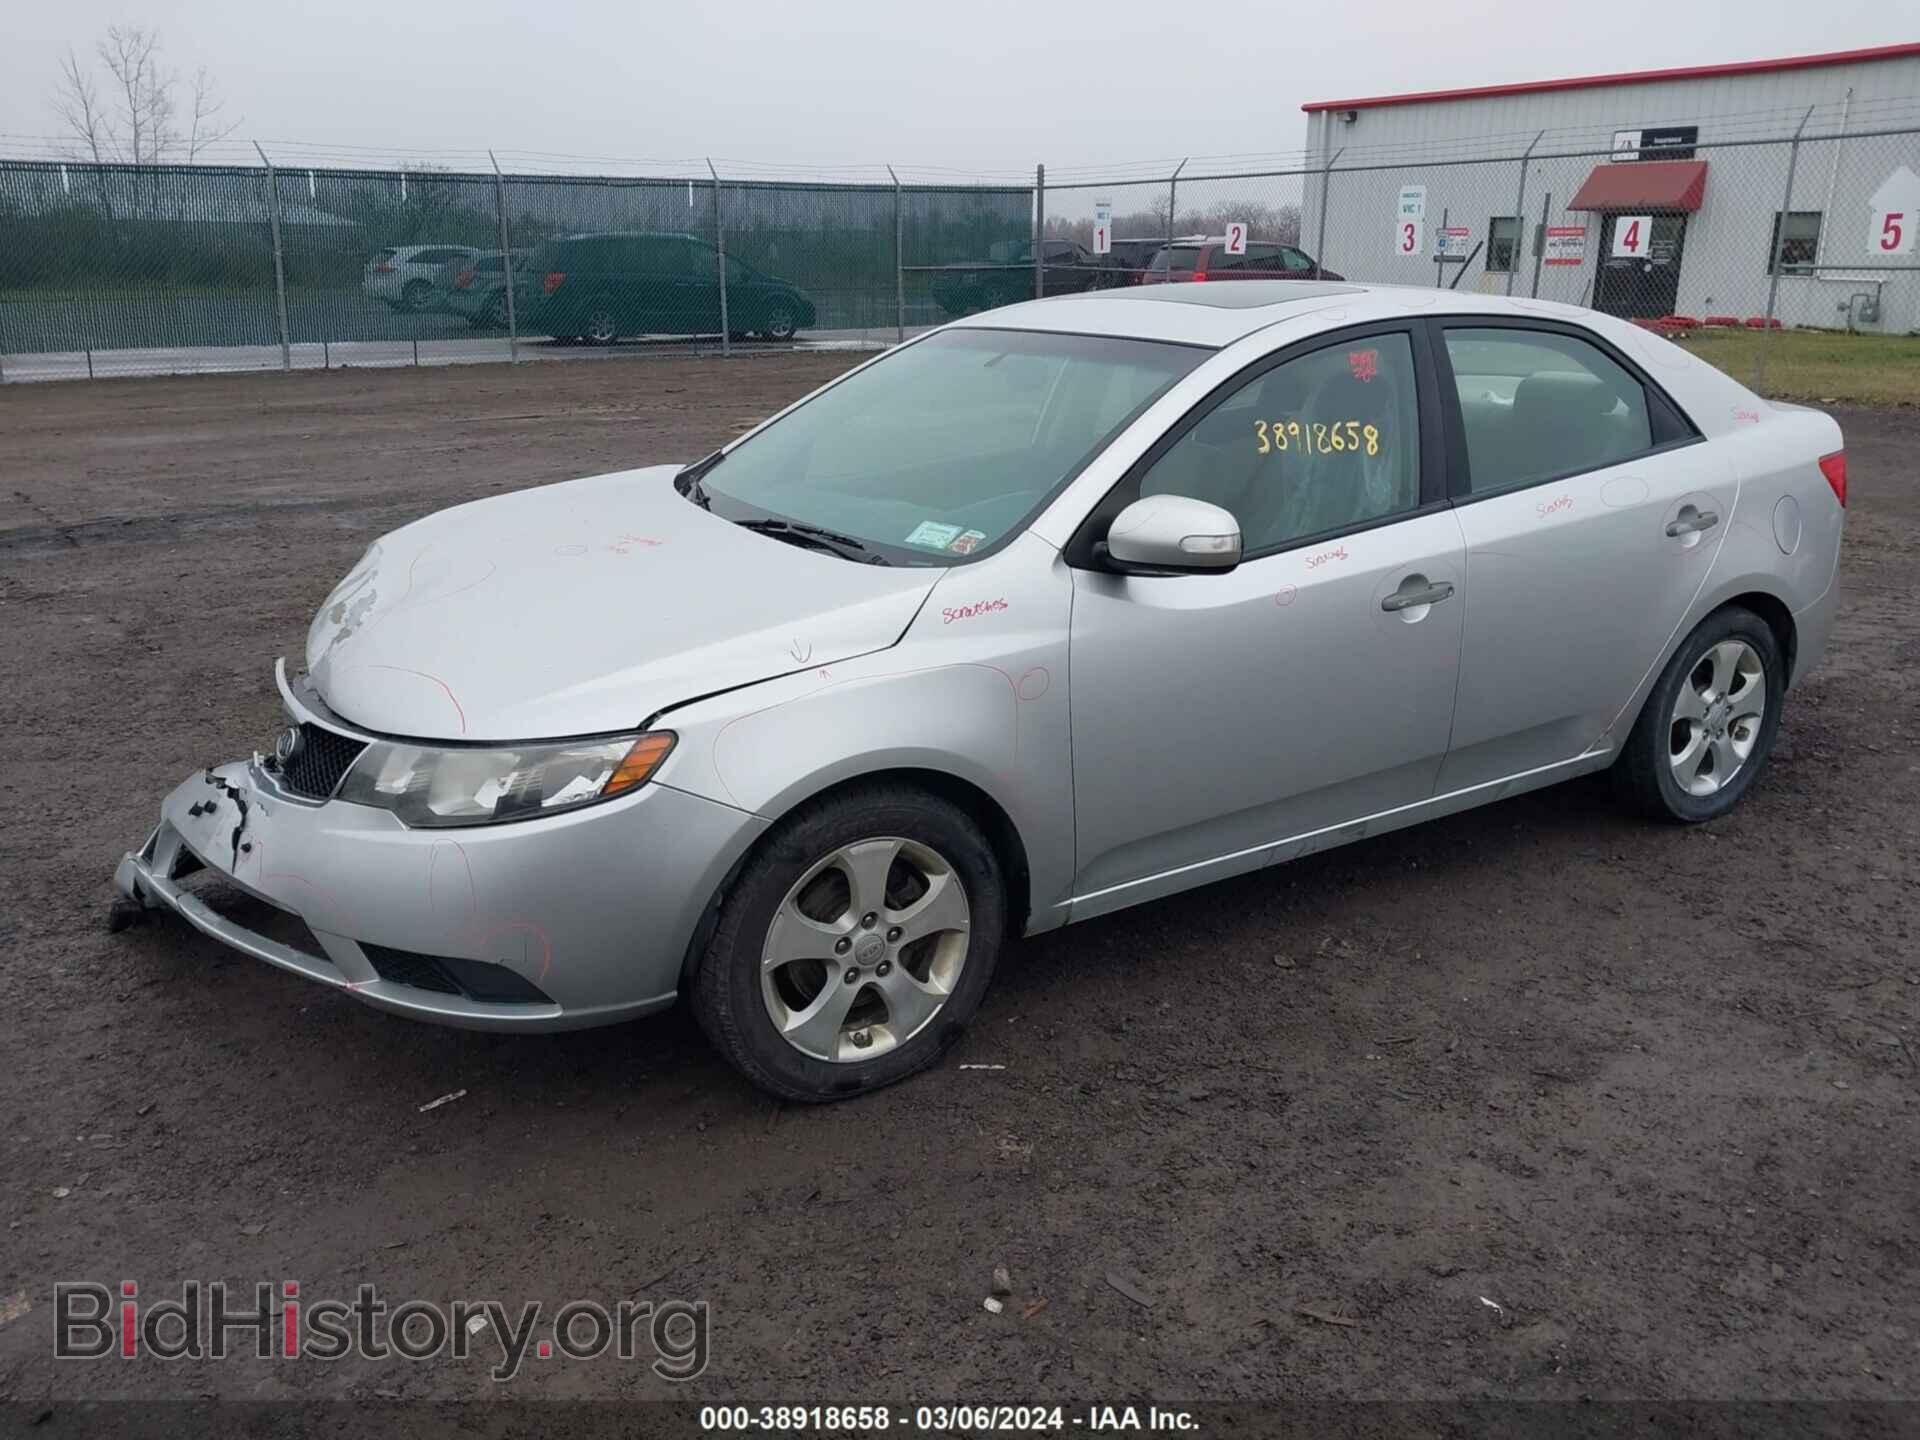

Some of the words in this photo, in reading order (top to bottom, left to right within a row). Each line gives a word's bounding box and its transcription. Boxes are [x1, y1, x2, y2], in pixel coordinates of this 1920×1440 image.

[1097, 227, 1105, 251] 1
[1230, 226, 1242, 252] 2
[1402, 223, 1416, 252] 3
[1623, 220, 1640, 253] 4
[1880, 212, 1904, 251] 5
[1254, 419, 1380, 456] 38918658
